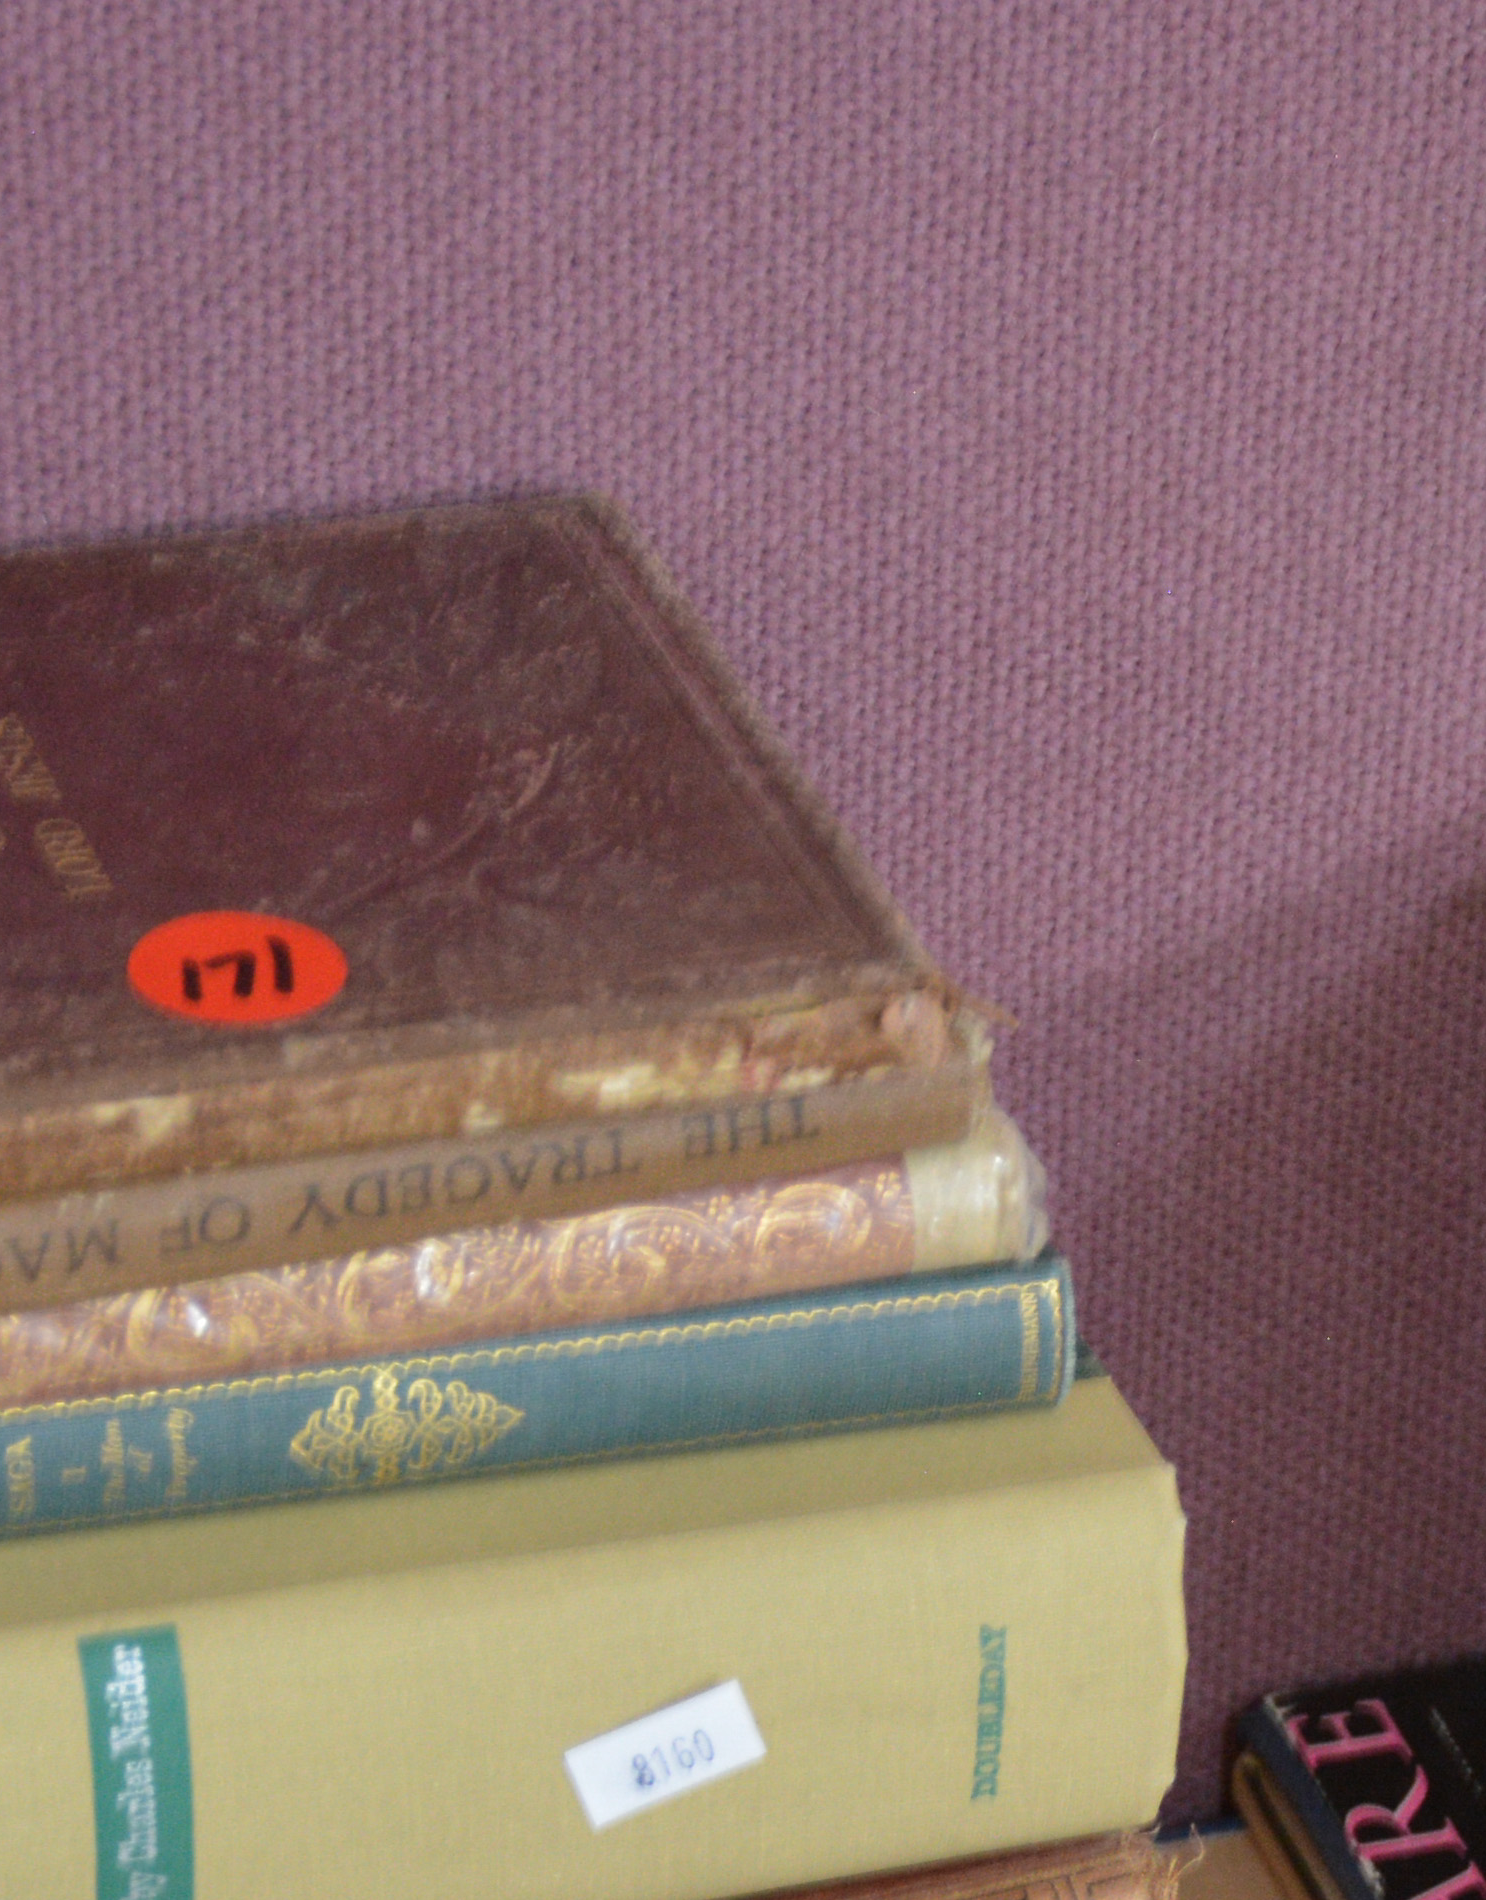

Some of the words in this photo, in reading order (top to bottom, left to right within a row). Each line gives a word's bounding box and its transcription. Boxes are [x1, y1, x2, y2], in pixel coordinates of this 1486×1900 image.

[181, 933, 295, 1004] 171
[680, 1095, 822, 1164] THE
[161, 1197, 252, 1258] OF
[289, 1130, 642, 1242] TRAGEDY
[106, 1643, 152, 1757] Neider
[970, 1622, 1010, 1805] DOUBLEDAY
[116, 1758, 159, 1865] Charles
